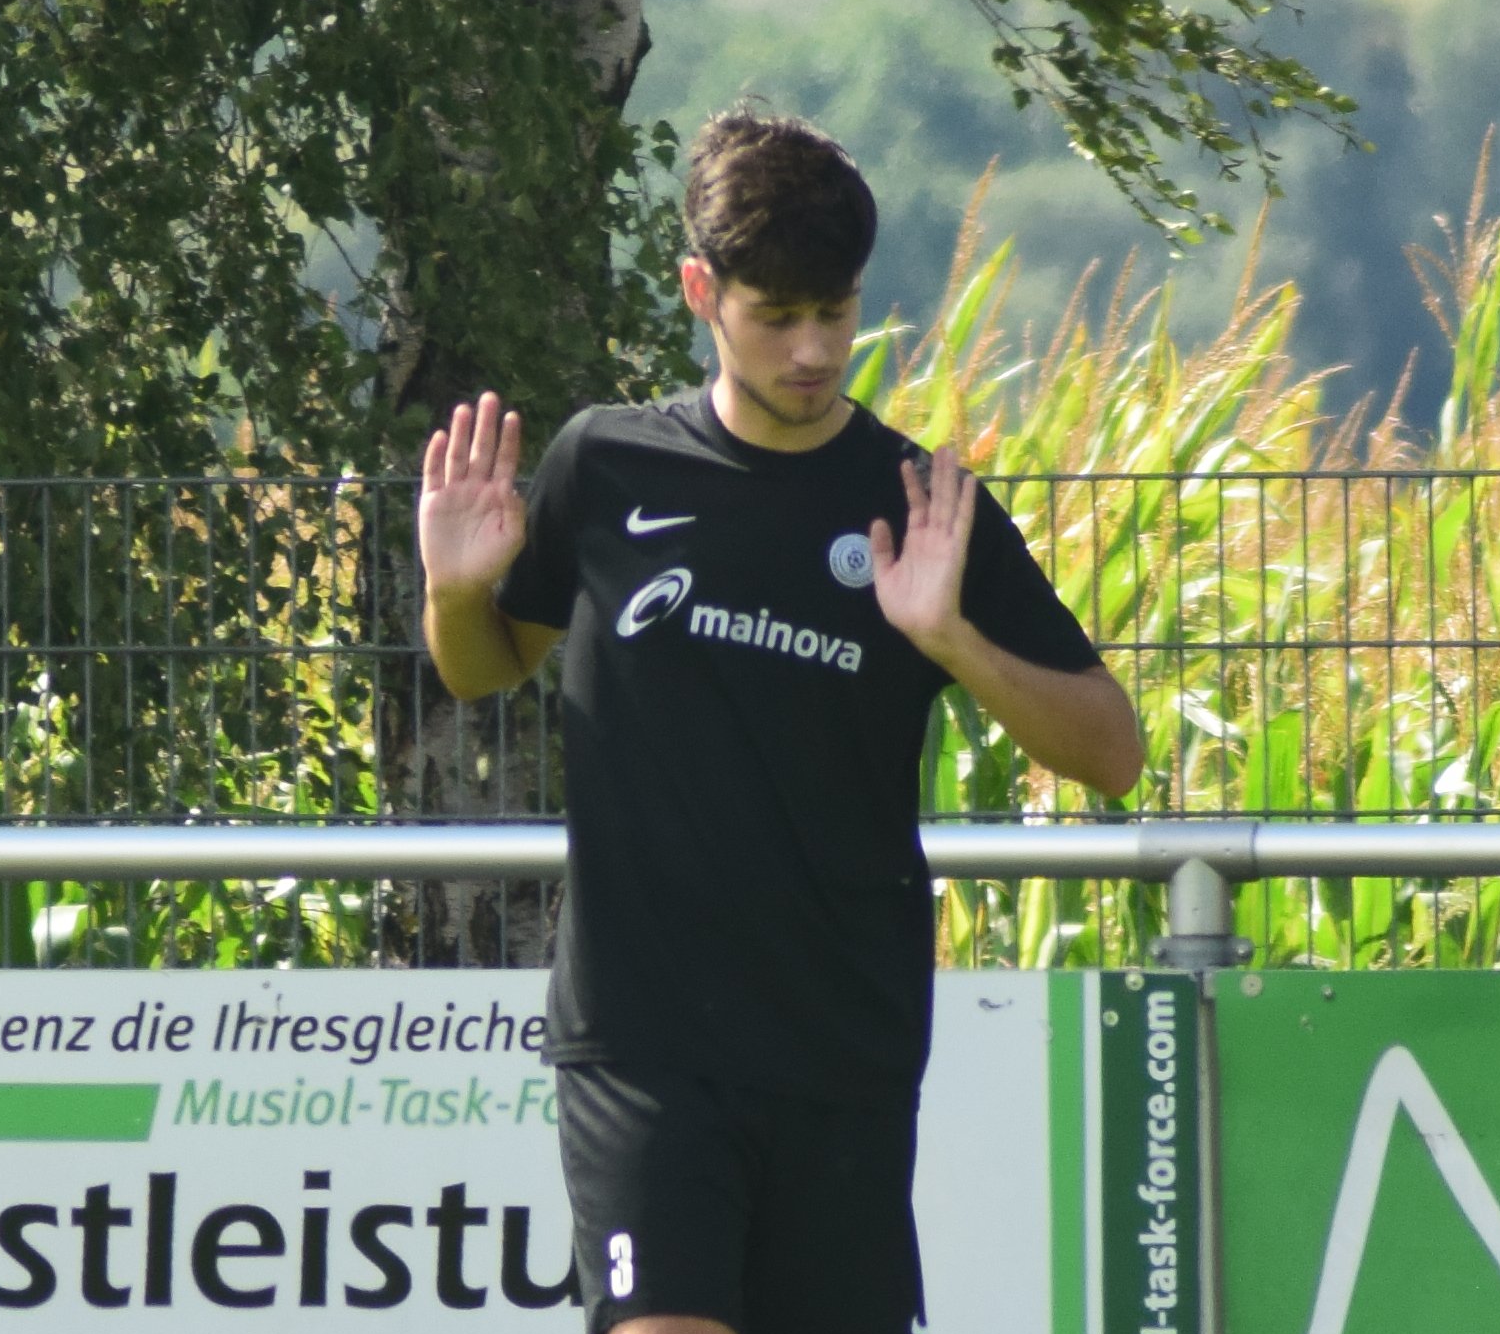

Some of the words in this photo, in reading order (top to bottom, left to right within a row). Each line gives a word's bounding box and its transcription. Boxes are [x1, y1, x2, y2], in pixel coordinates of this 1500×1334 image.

[689, 603, 863, 672] mainova
[111, 1001, 195, 1052] die
[213, 1001, 546, 1065] Ihresgleiche
[609, 1232, 634, 1298] 3
